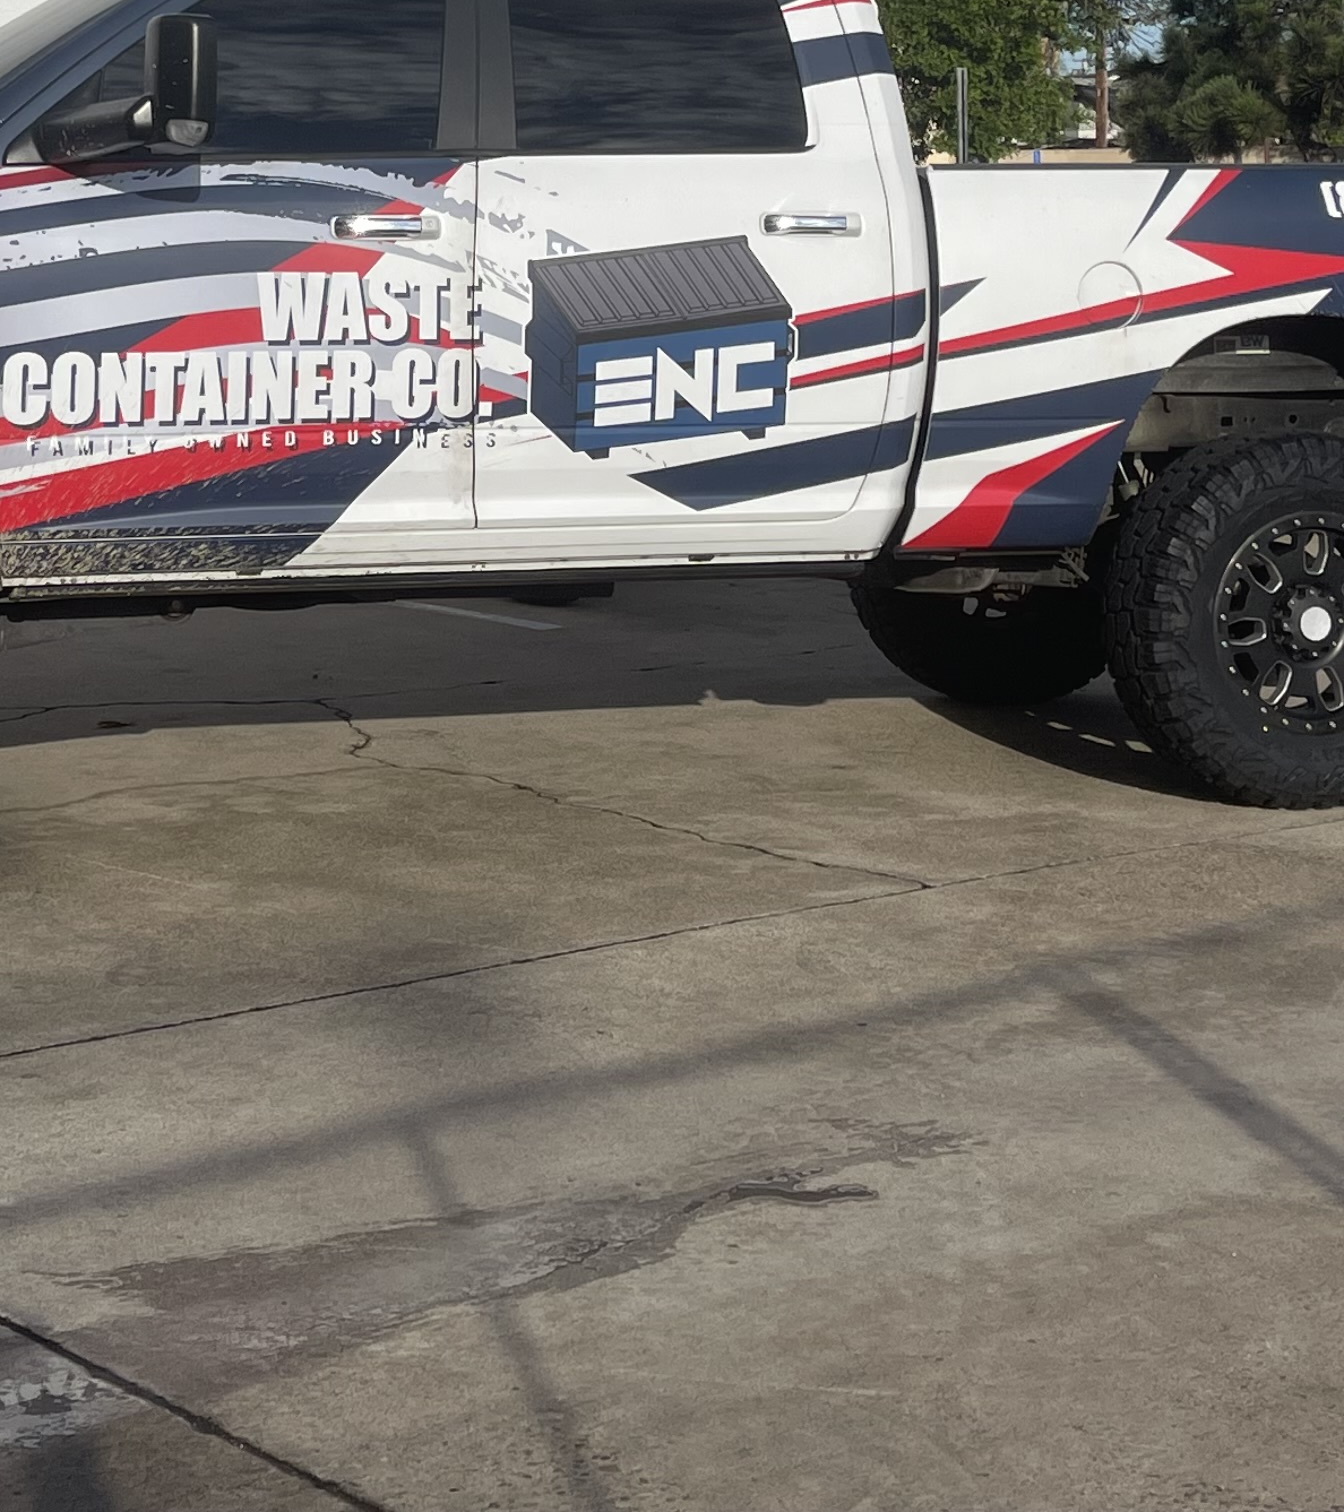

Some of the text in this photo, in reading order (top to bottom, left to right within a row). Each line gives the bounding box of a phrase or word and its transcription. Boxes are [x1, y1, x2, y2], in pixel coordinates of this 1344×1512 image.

[256, 271, 483, 346] WASTE
[2, 348, 493, 425] CONTAINER CO.
[593, 341, 775, 427] ENC
[27, 428, 497, 457] FAMILY OWNED BUSINESS
